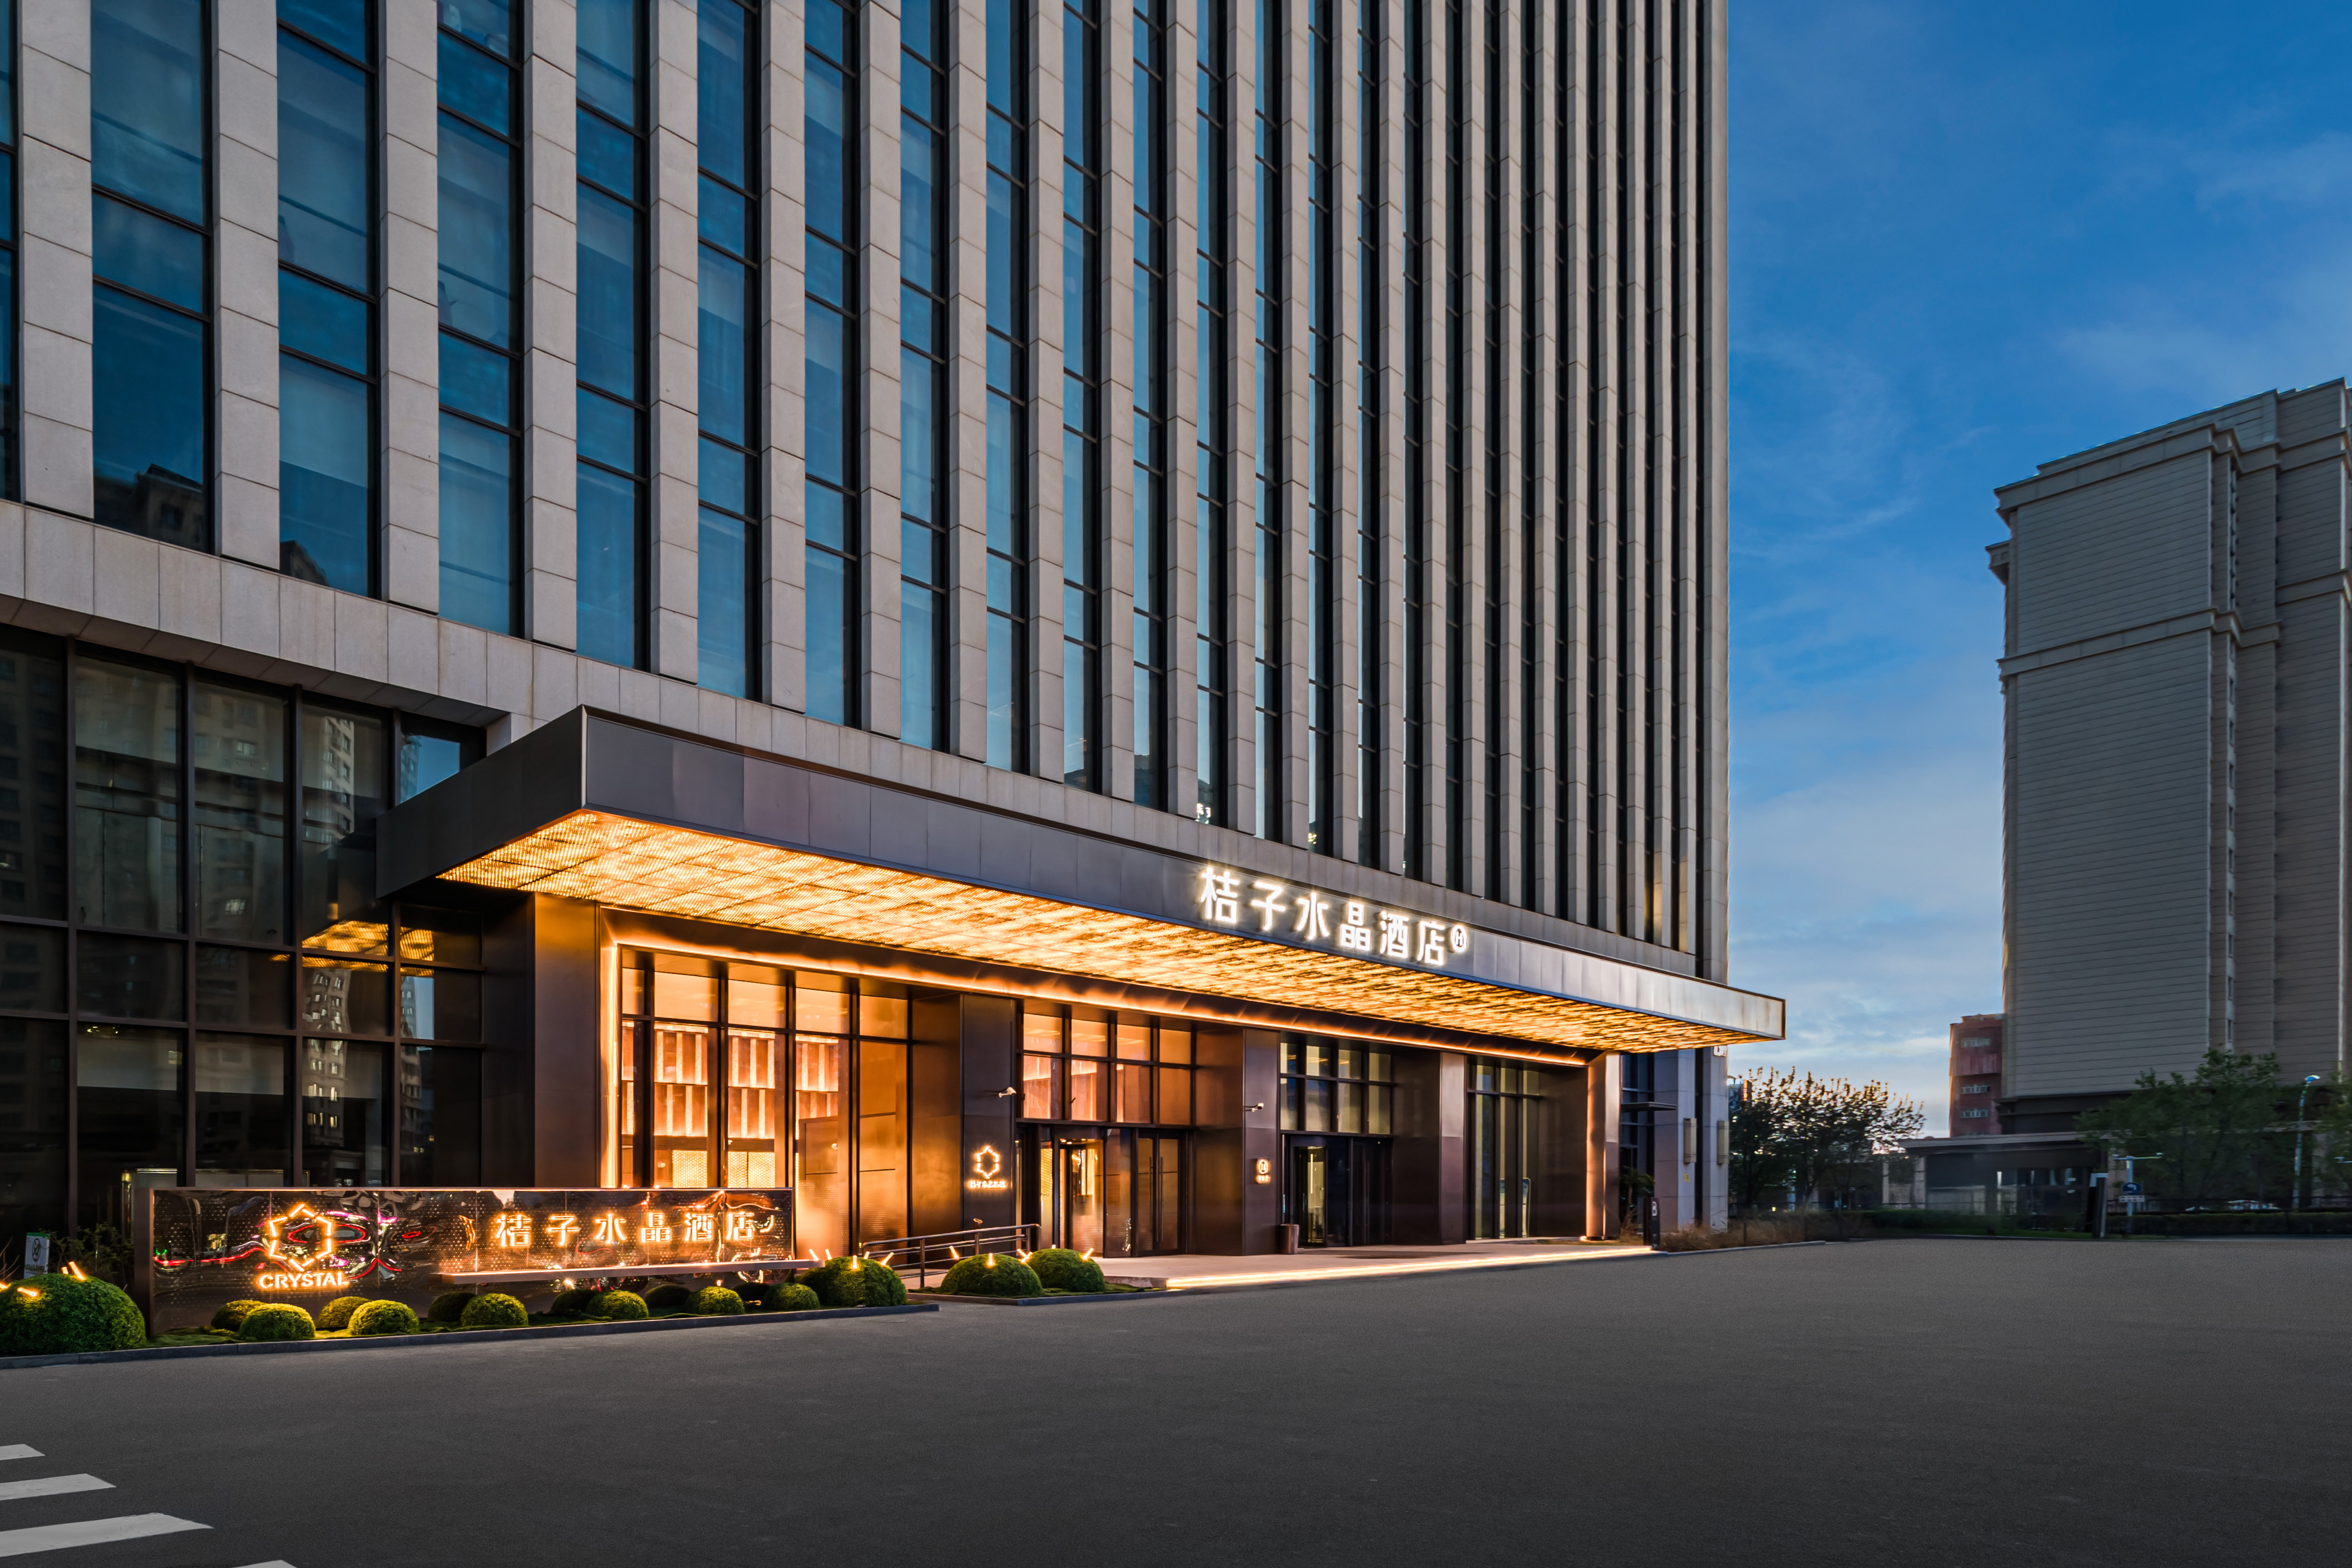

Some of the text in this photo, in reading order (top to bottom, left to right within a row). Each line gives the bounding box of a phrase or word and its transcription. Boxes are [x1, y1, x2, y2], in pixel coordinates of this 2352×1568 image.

[1201, 867, 1445, 965] 桔子水晶酒店
[495, 1212, 755, 1247] 桔子水晶酒店
[260, 1272, 350, 1288] CRYSTAL
